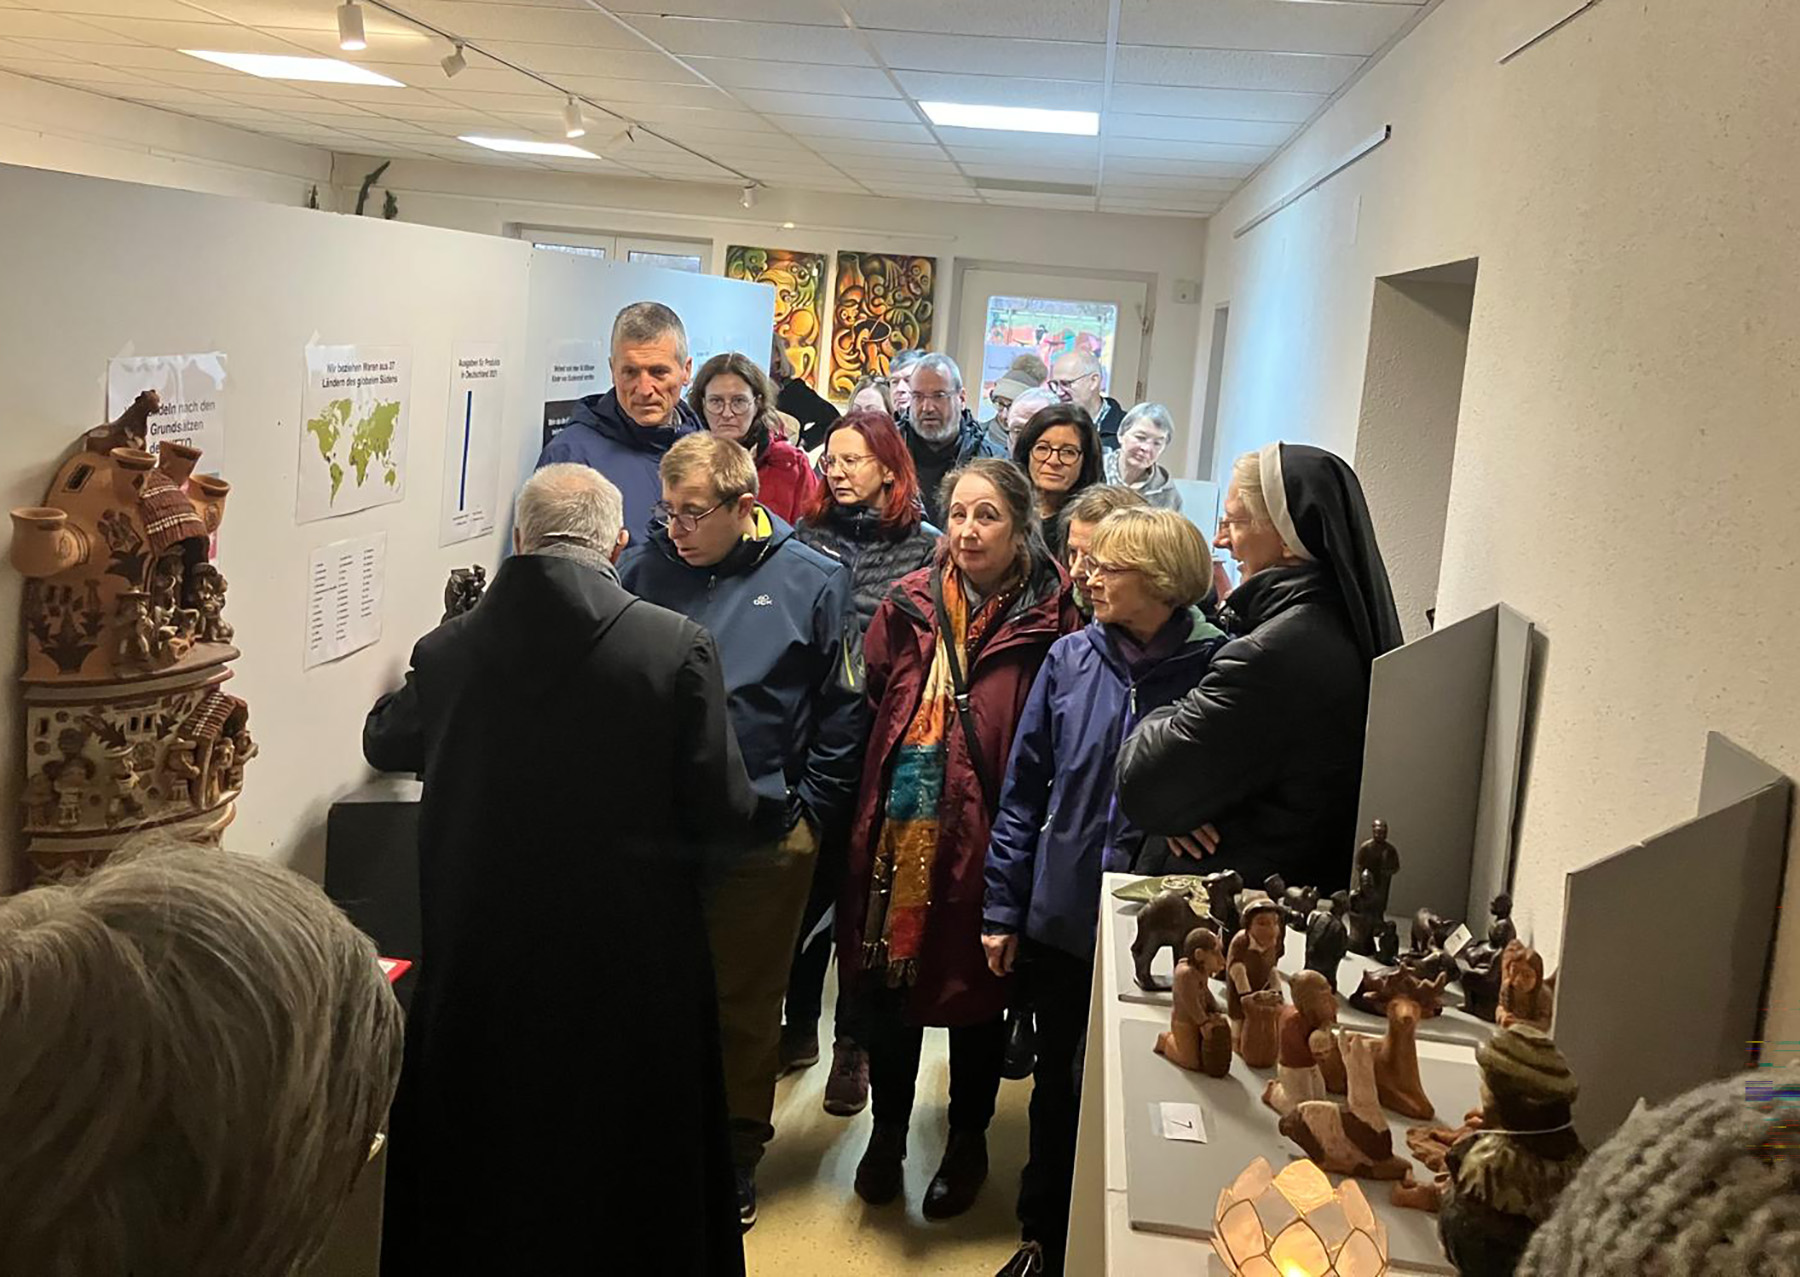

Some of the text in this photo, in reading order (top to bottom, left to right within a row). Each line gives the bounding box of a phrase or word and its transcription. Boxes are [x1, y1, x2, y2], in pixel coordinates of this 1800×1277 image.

[178, 401, 200, 413] nach
[200, 399, 216, 411] den
[149, 442, 160, 454] de
